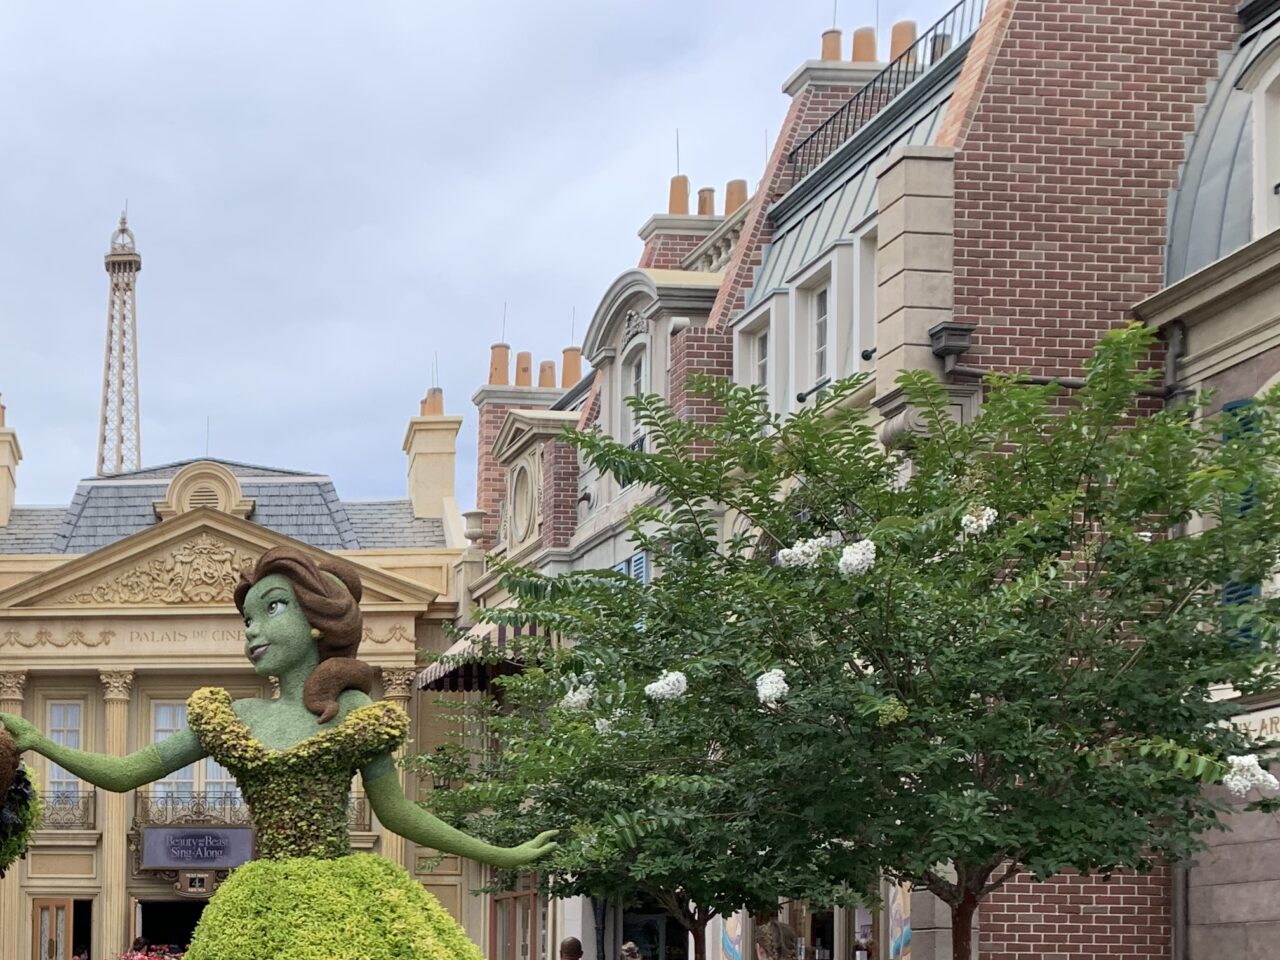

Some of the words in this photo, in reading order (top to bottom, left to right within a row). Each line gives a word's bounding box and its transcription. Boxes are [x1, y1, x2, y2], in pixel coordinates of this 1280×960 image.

[129, 630, 188, 643] PALAIS
[192, 630, 207, 640] DU
[166, 835, 198, 848] Beauty
[205, 835, 229, 847] Beast
[171, 847, 223, 861] Sing-Along
